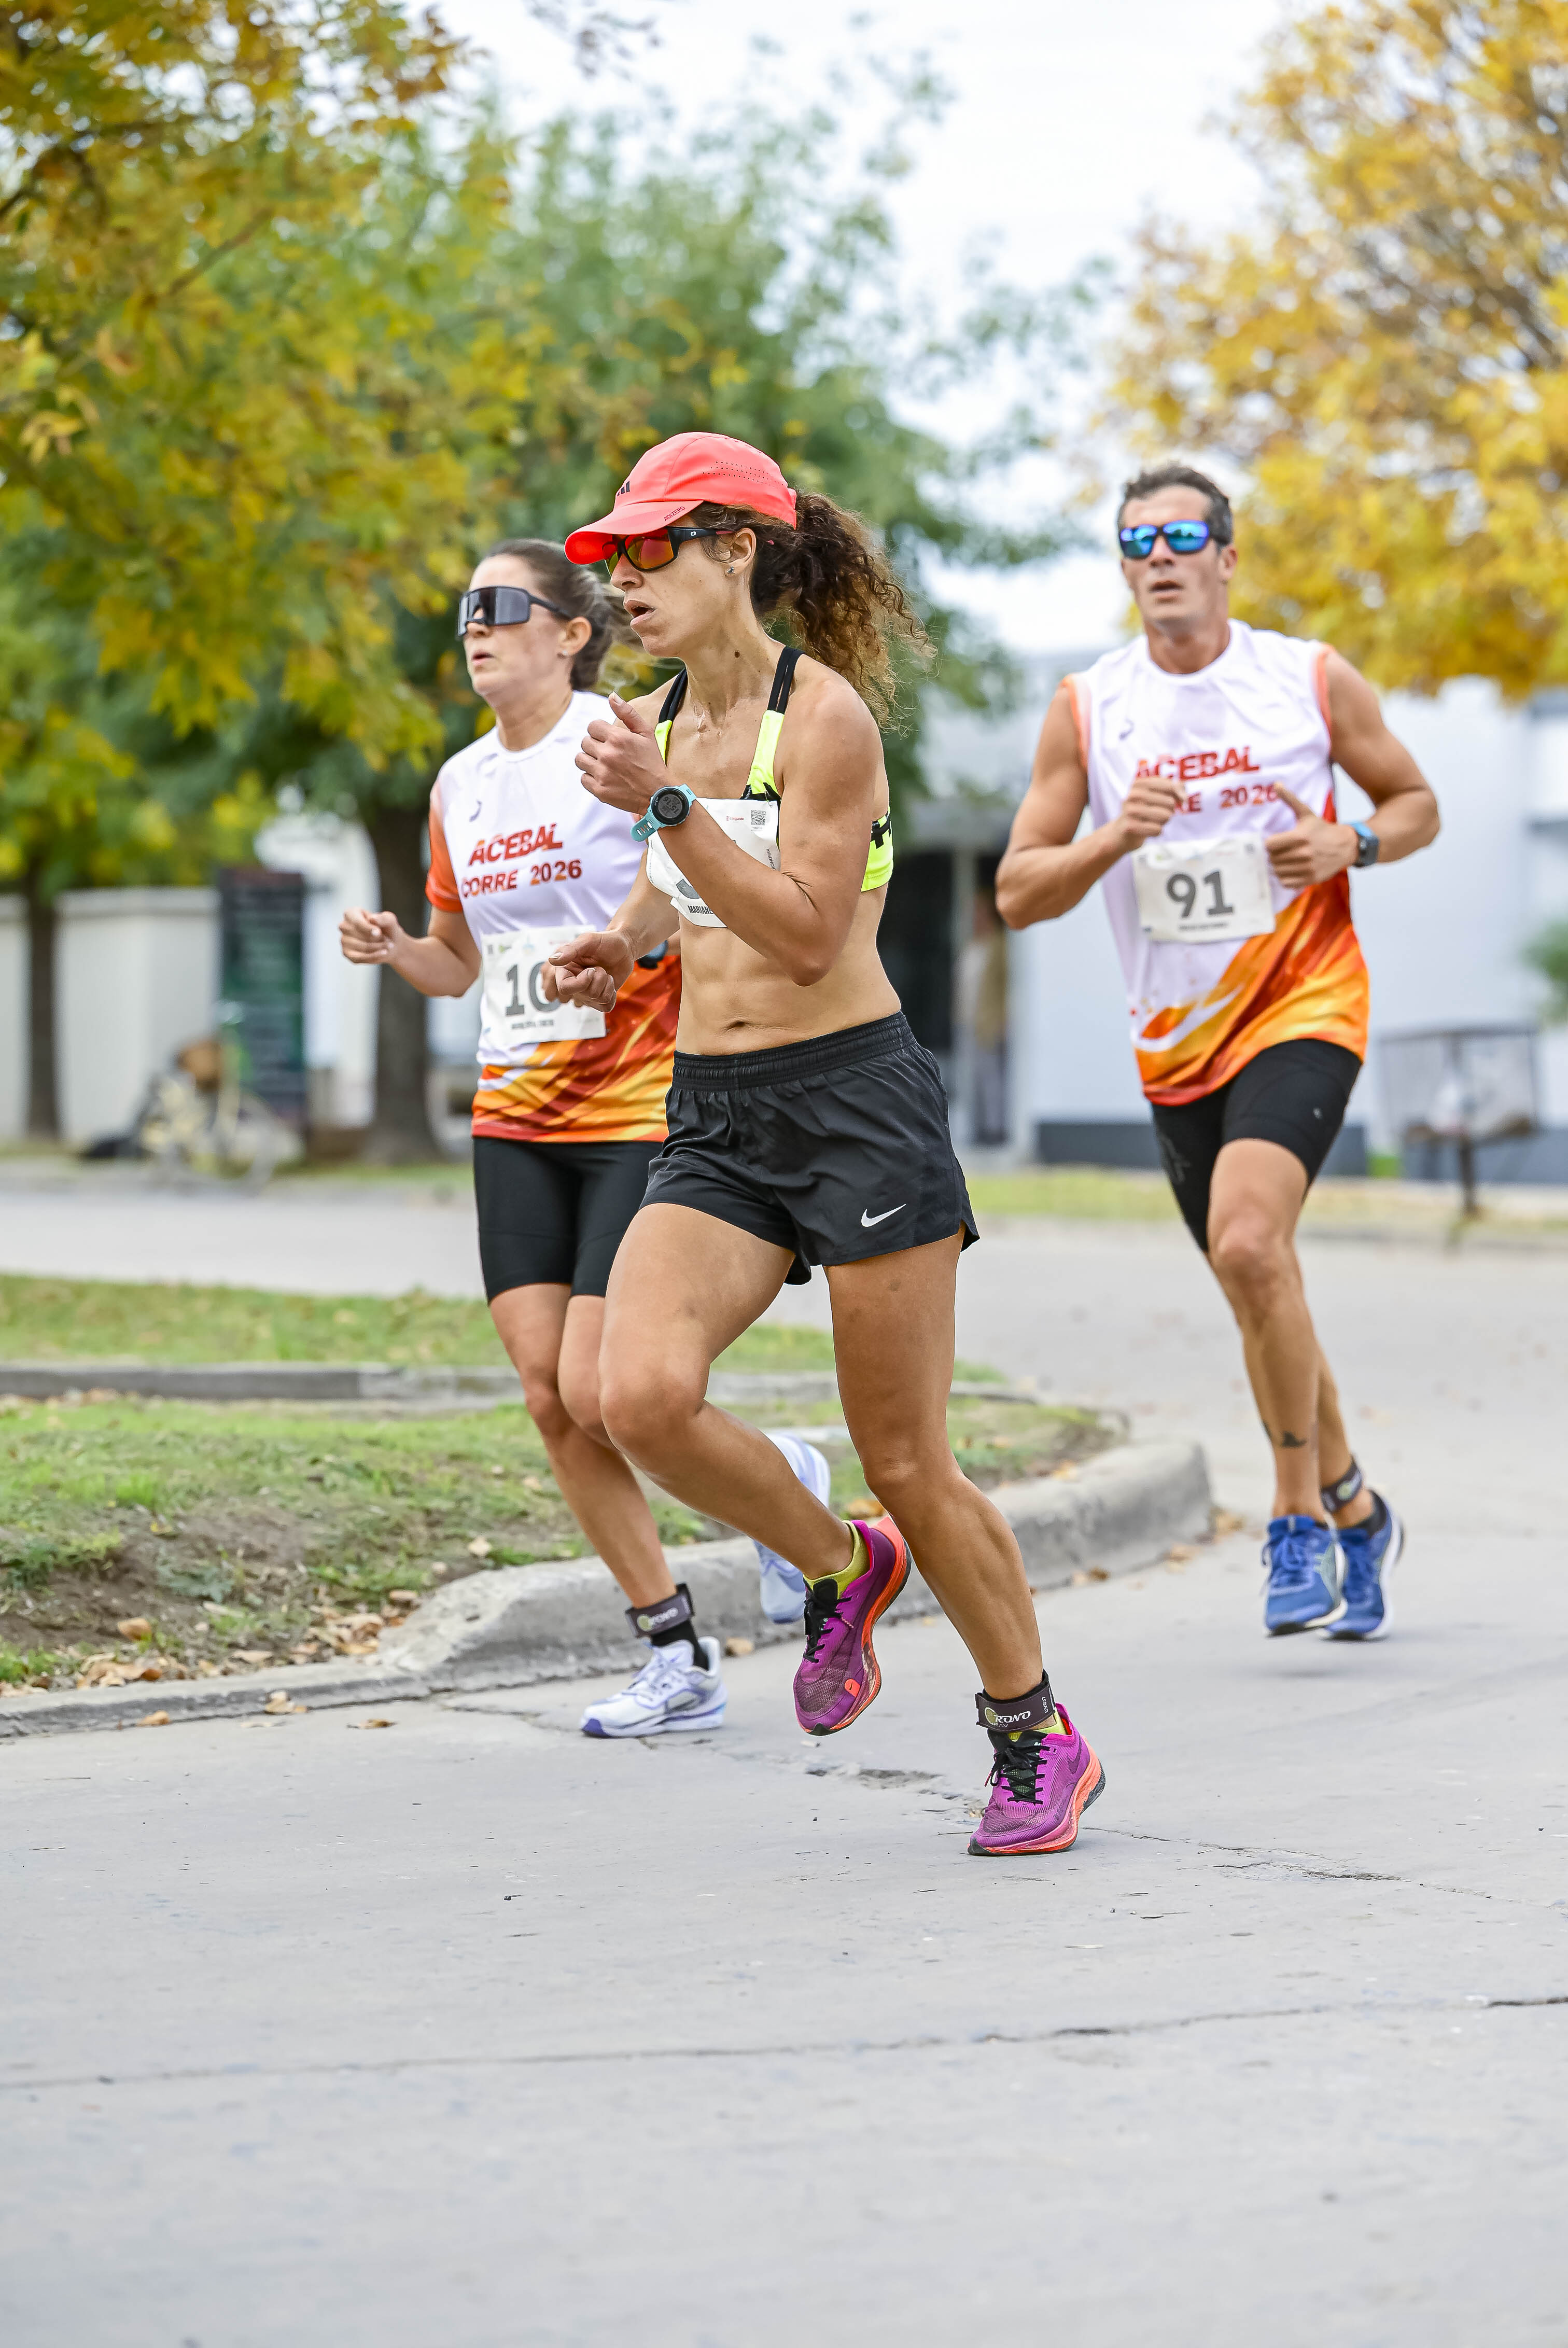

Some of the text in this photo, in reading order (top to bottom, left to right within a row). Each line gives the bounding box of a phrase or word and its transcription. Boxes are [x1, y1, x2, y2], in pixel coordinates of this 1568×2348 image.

[664, 506, 685, 521] ADIZERO
[1221, 784, 1278, 808] 2026
[469, 823, 563, 866] ACEBAL
[461, 859, 582, 898] CORRE 2026
[1167, 871, 1234, 918] 91
